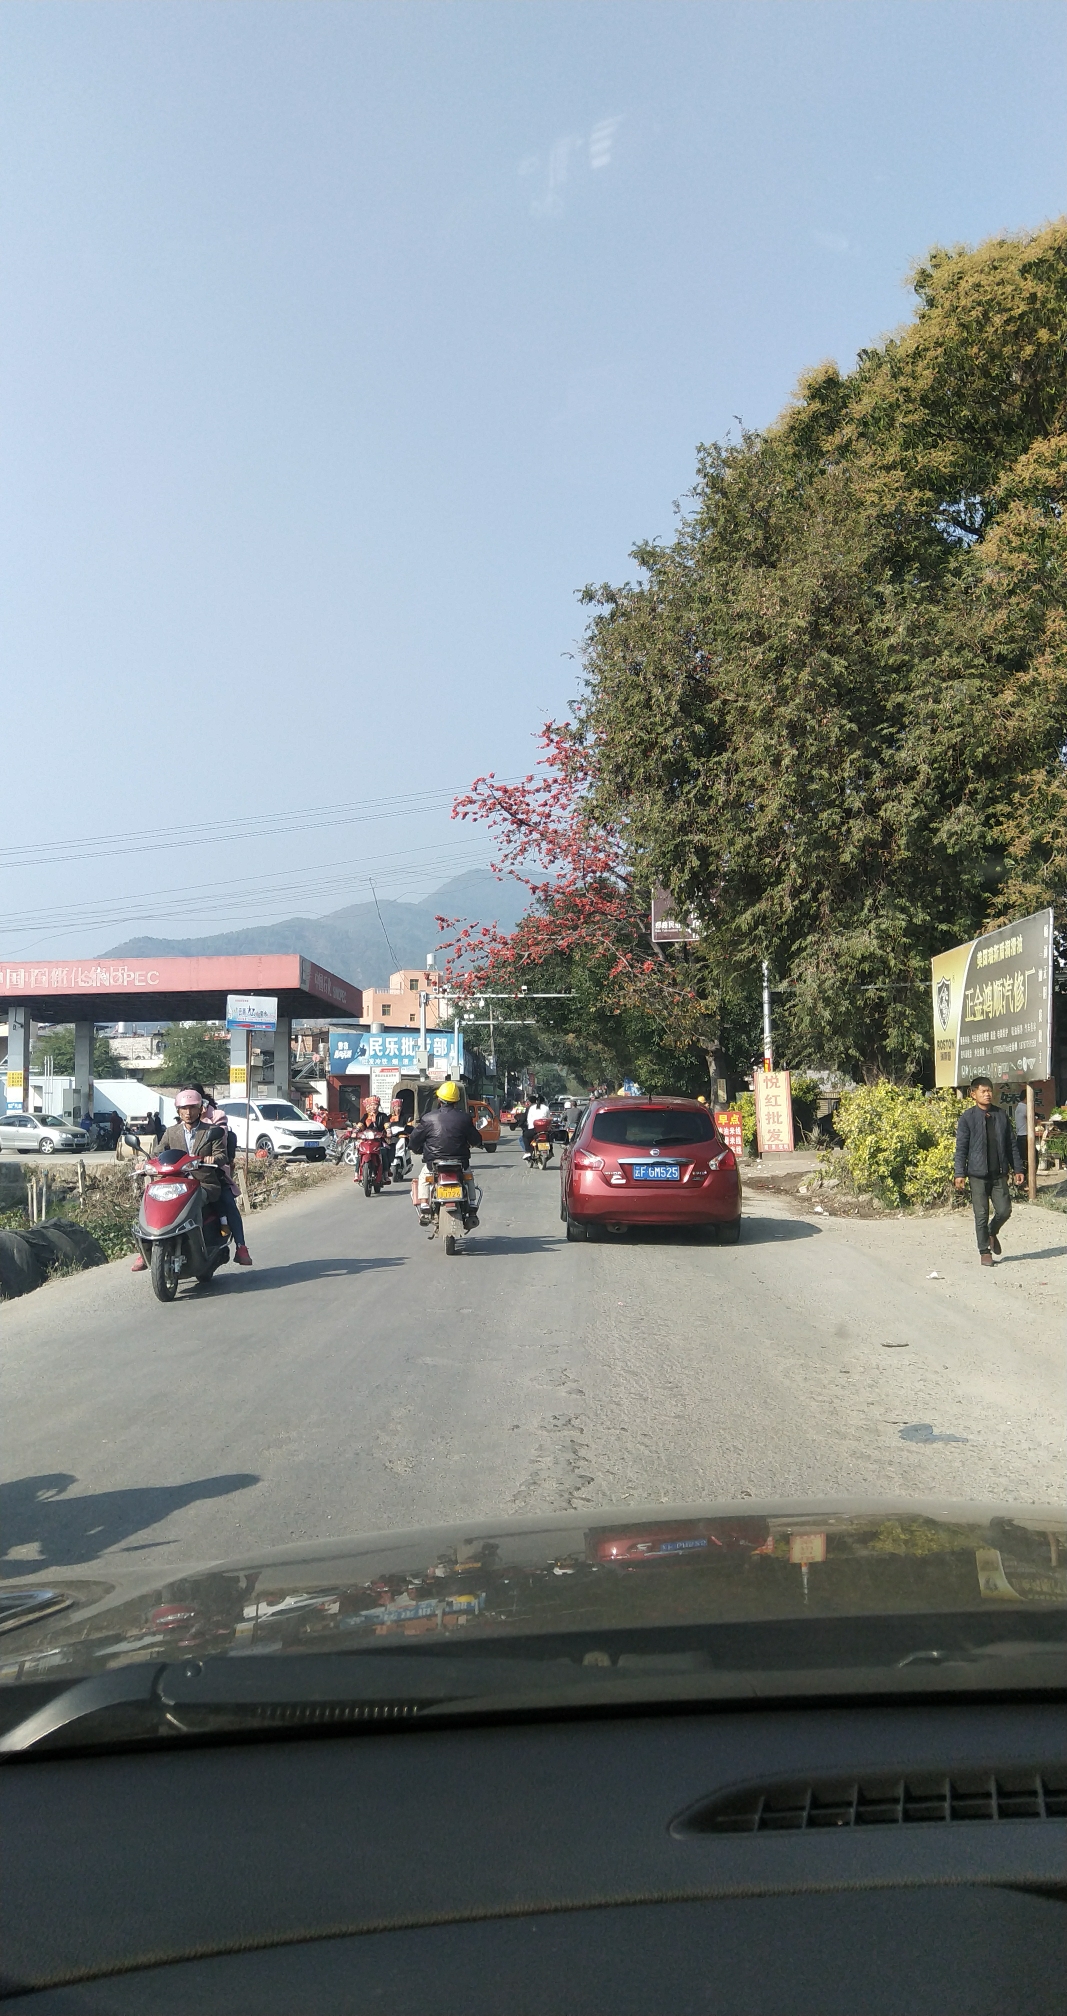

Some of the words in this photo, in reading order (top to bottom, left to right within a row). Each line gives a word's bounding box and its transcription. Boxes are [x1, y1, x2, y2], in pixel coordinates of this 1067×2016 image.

[368, 1037, 448, 1057] 民乐批发部
[763, 1075, 783, 1143] 悦红批发
[717, 1113, 741, 1126] 早点
